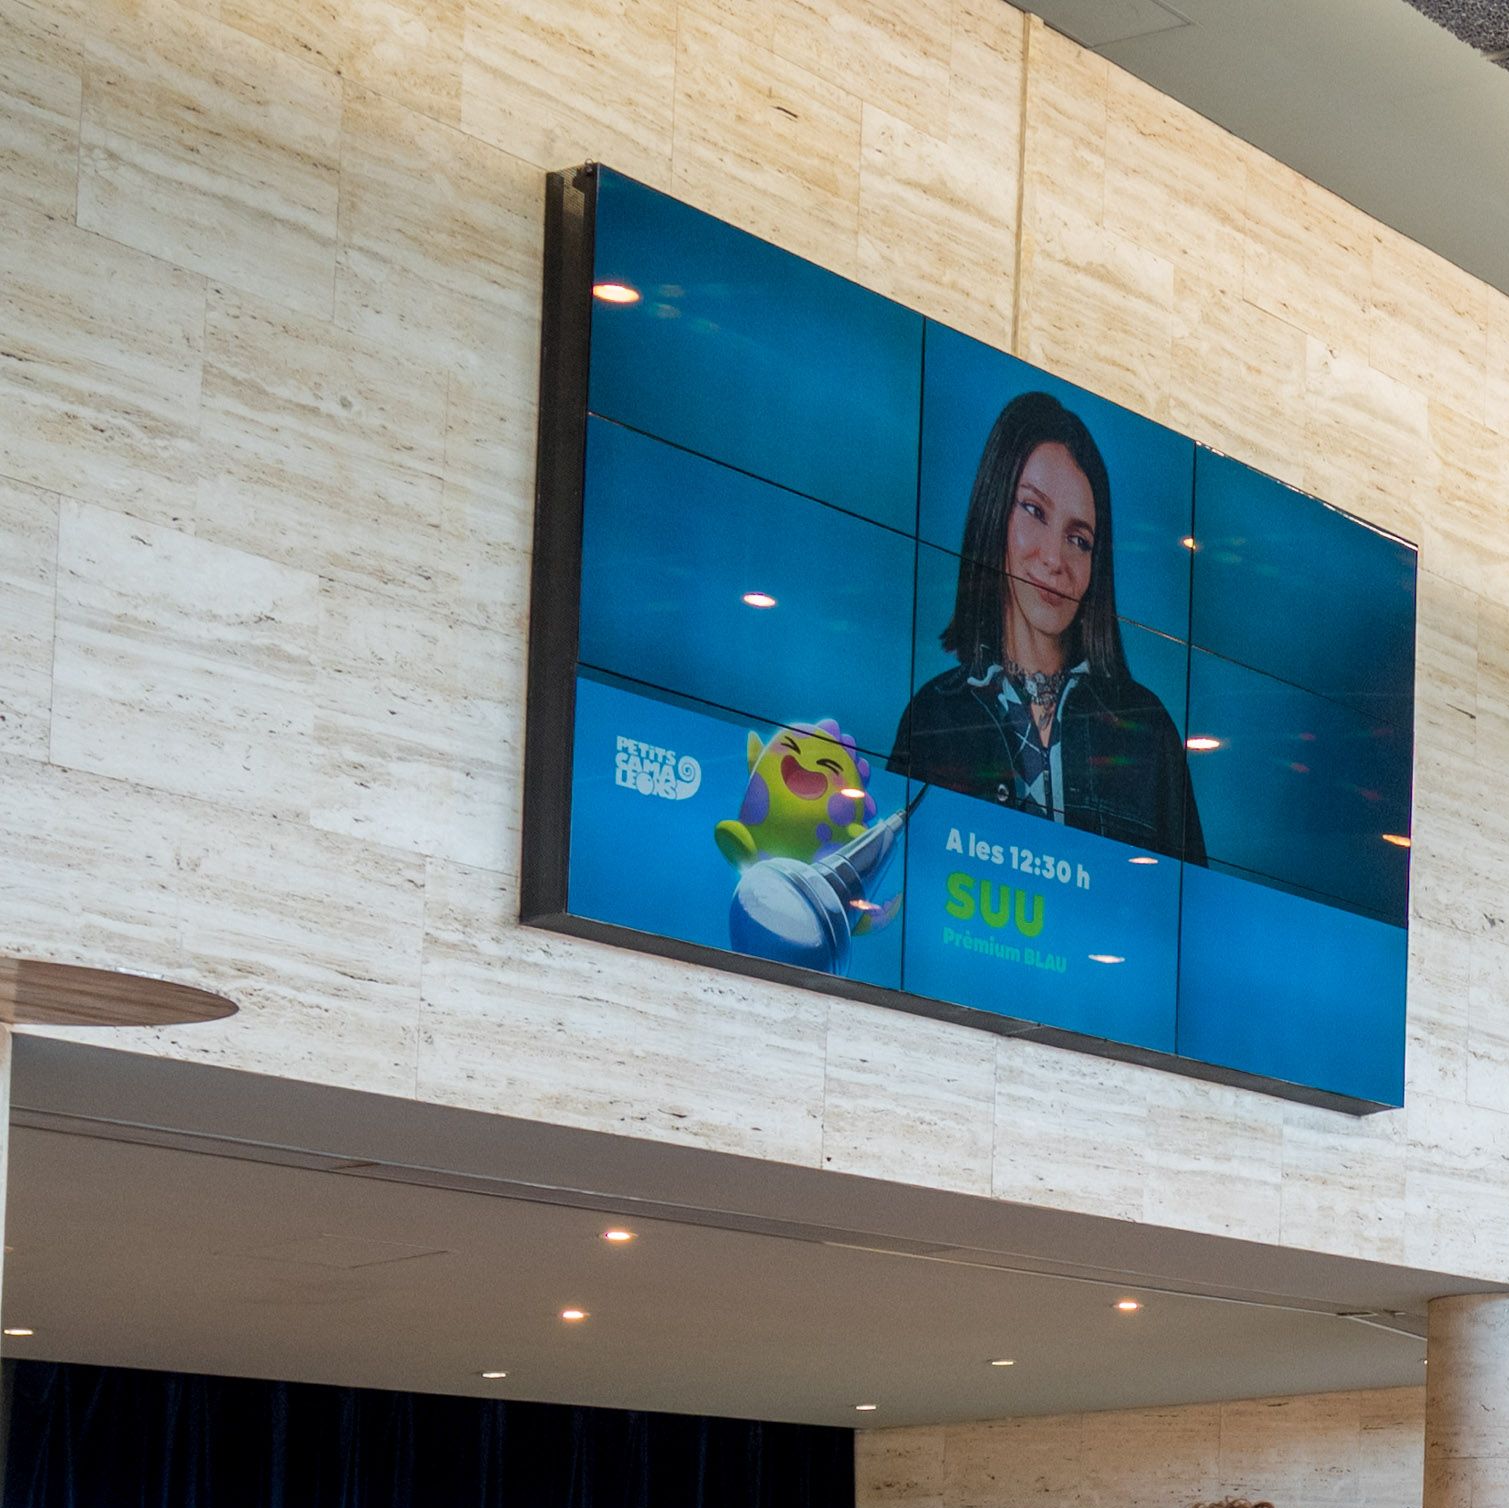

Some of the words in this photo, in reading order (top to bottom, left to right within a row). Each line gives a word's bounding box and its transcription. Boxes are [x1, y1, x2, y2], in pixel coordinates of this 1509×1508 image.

[946, 827, 963, 854] A
[969, 832, 1004, 865] les
[1010, 846, 1071, 884] 12:30
[1076, 864, 1090, 890] h
[945, 872, 1044, 937] SUU
[943, 926, 1020, 962] Prèmium
[1024, 948, 1067, 974] BLAU
